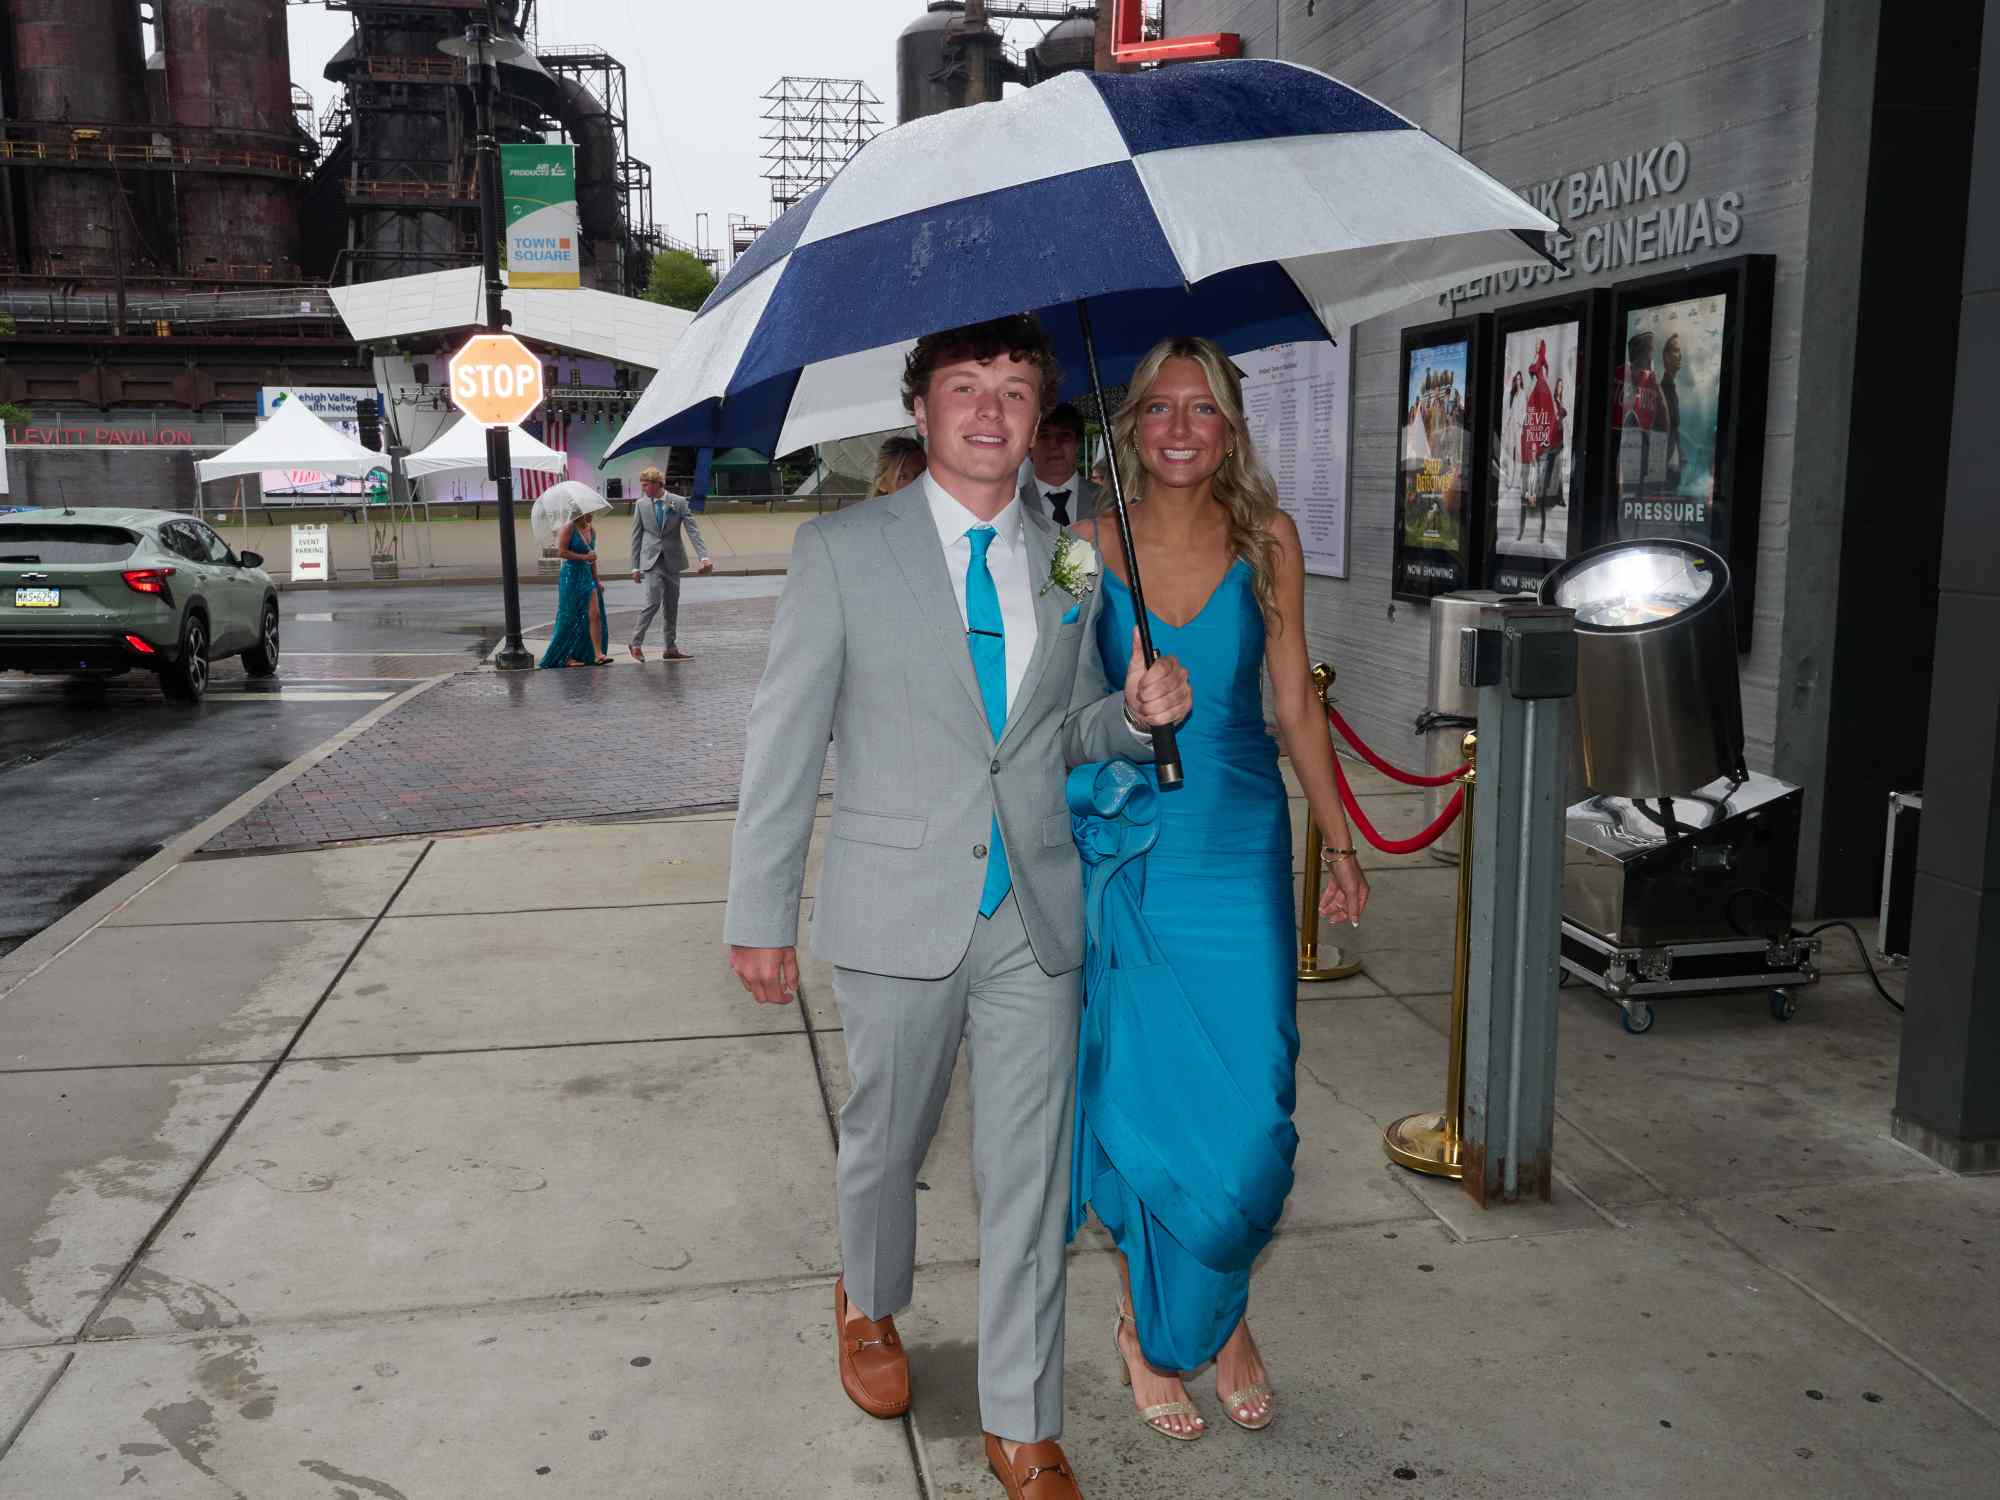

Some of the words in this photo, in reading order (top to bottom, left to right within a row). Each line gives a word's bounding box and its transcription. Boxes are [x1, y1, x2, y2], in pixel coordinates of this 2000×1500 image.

[1568, 140, 1689, 219] BANKO
[1581, 192, 1744, 273] CINEMAS
[513, 237, 556, 249] TOWN
[513, 250, 572, 261] SQUARE
[458, 364, 535, 399] STOP
[298, 392, 326, 404] ehigh
[327, 393, 358, 404] Valley
[1524, 408, 1551, 426] DEVIL
[11, 427, 88, 446] LEVITT
[95, 426, 193, 446] PAVILION
[1624, 502, 1705, 522] PRESSURE
[1407, 565, 1422, 577] NOW
[1423, 565, 1454, 579] SHOWING
[1501, 576, 1518, 587] NOW
